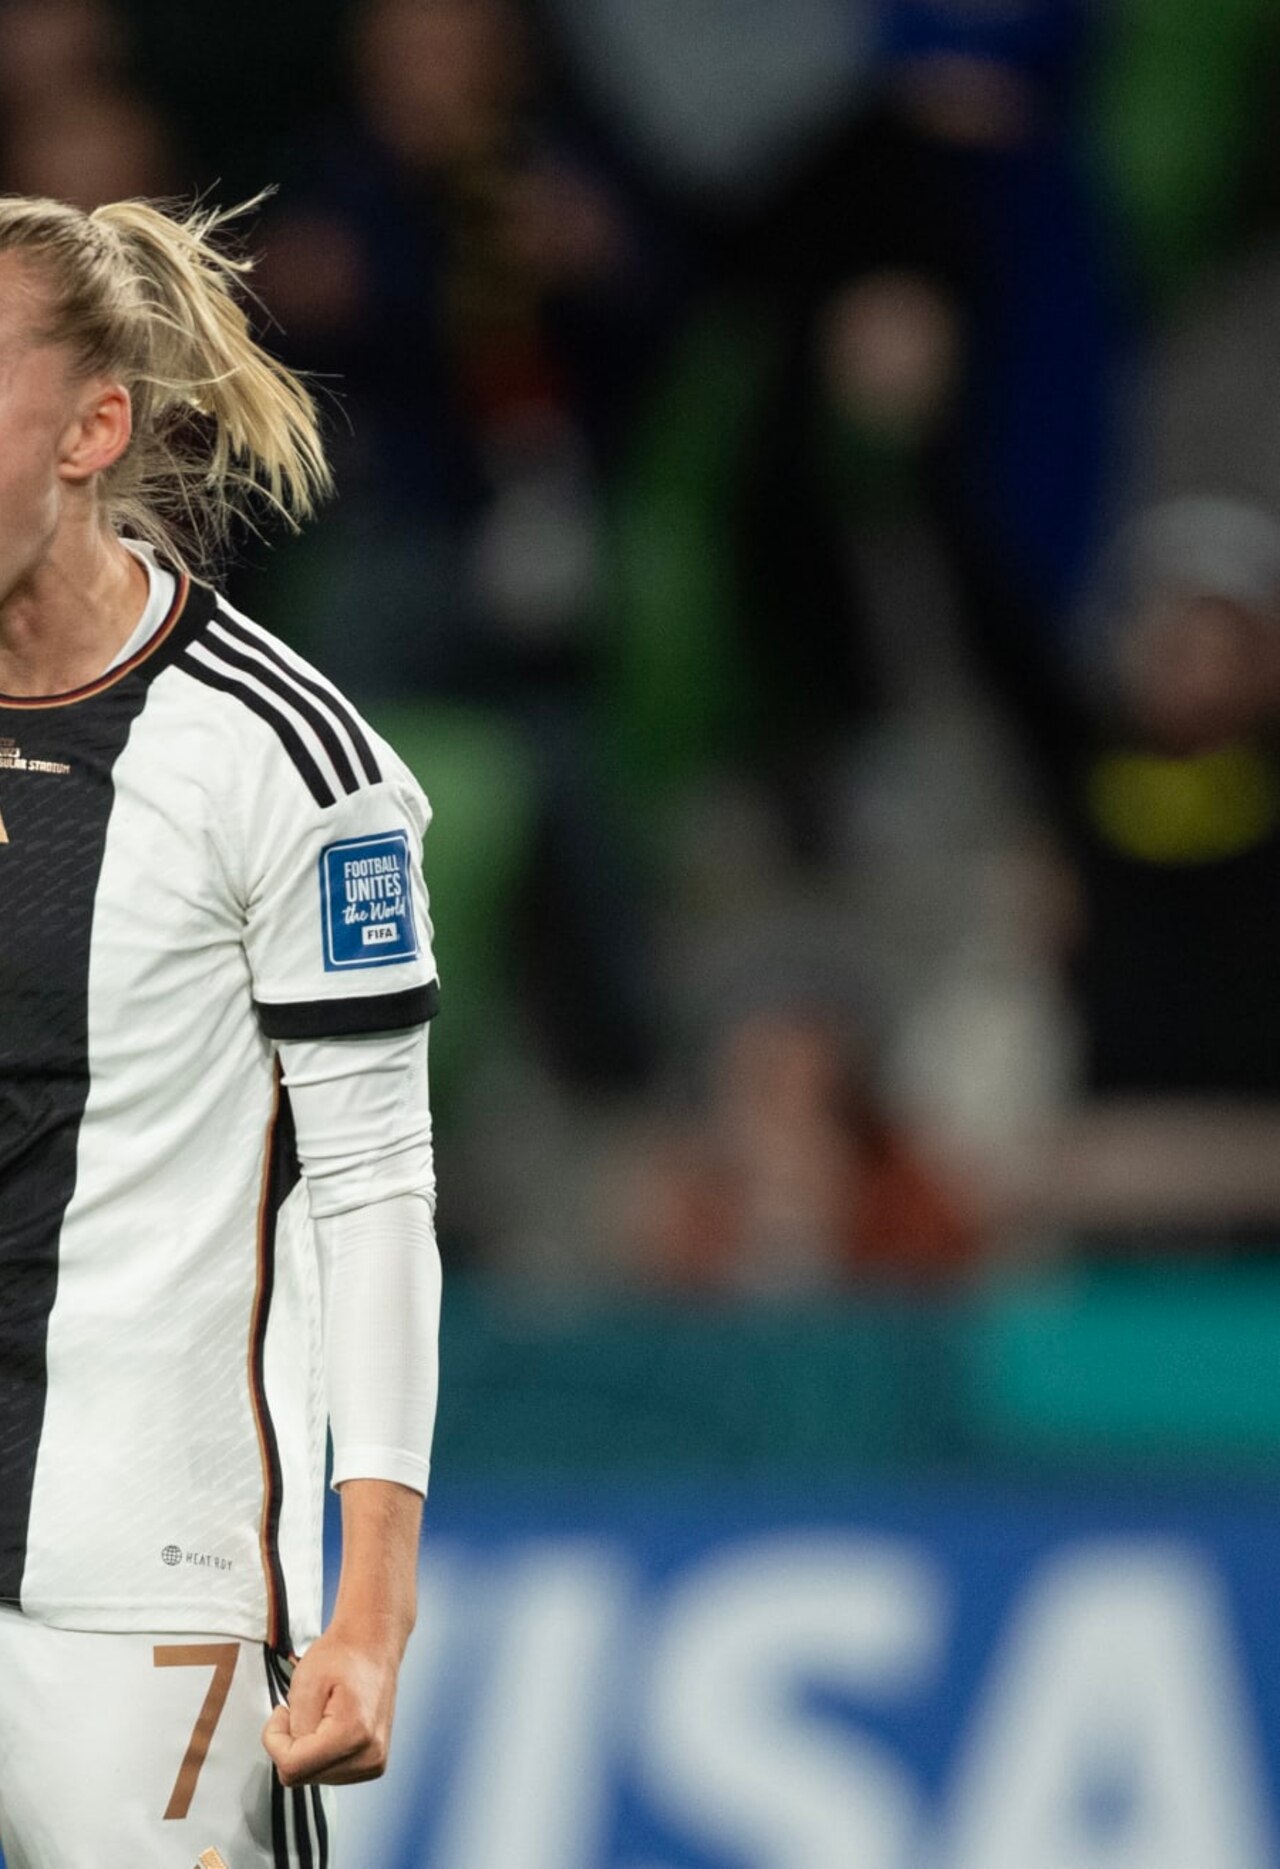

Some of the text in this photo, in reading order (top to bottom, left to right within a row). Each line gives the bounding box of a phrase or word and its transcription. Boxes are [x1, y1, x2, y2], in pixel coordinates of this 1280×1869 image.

[28, 760, 71, 774] STADIUM
[344, 854, 400, 879] FOOTBALL
[344, 873, 402, 902] UNITES
[341, 897, 406, 925] the World
[367, 927, 393, 940] FIFA
[153, 1642, 241, 1820] 7
